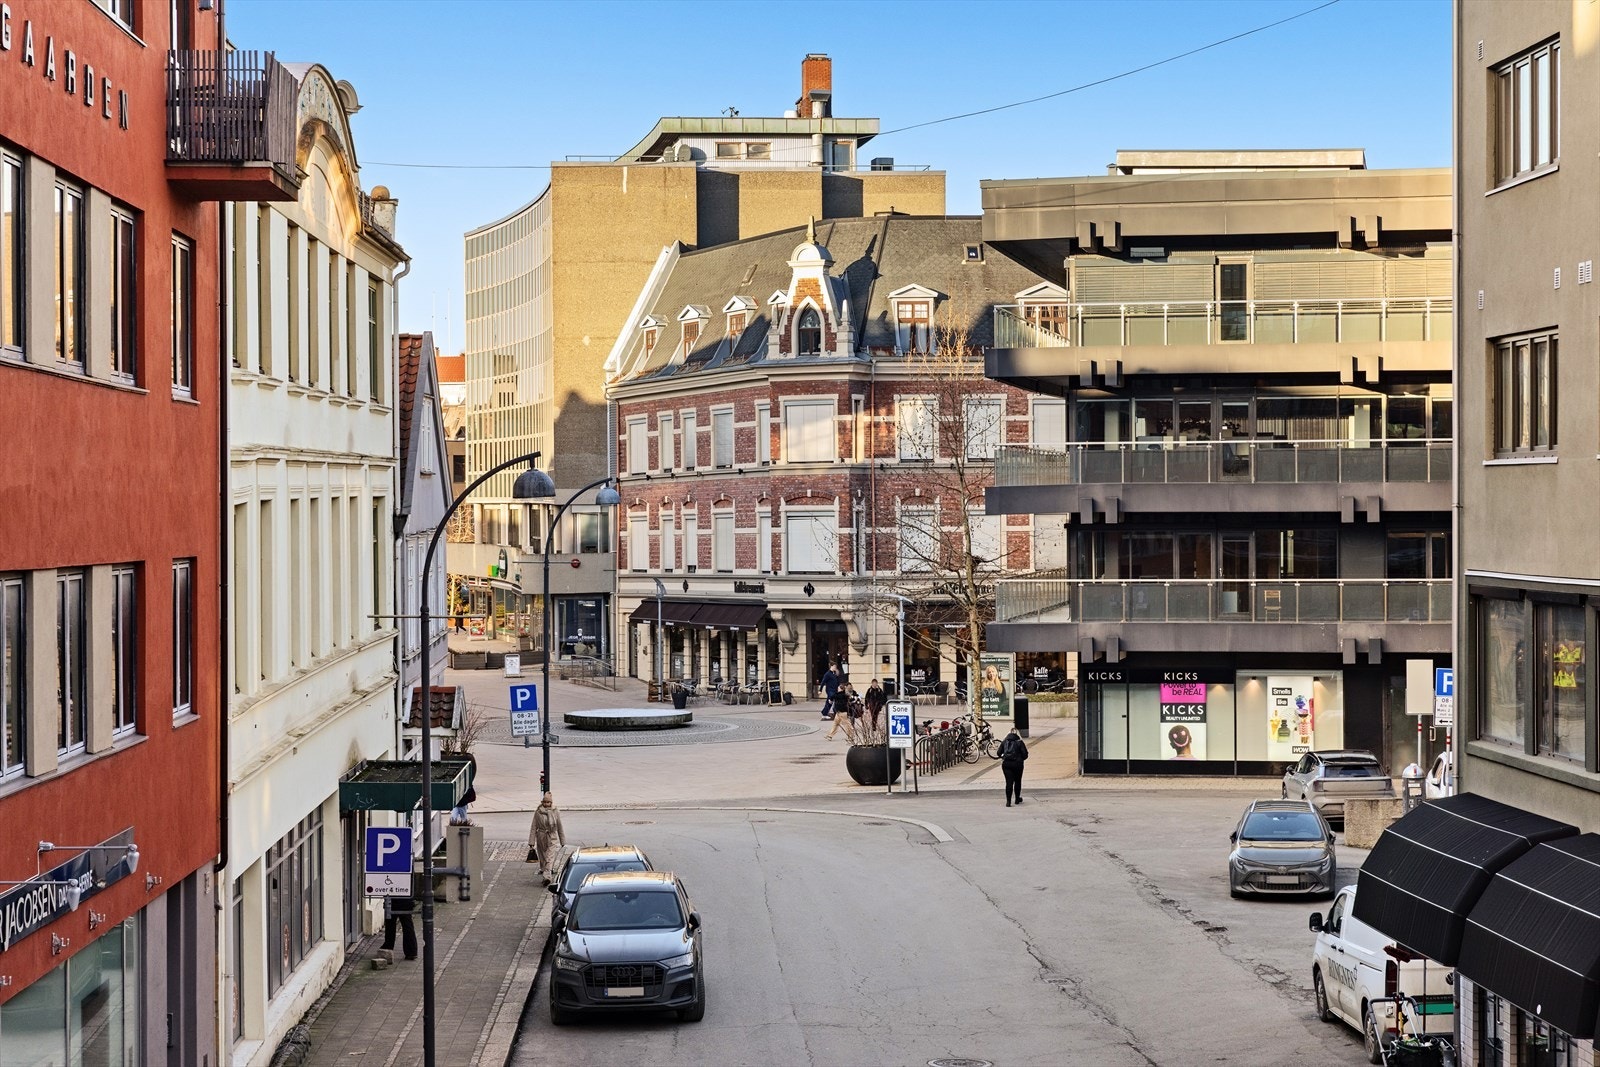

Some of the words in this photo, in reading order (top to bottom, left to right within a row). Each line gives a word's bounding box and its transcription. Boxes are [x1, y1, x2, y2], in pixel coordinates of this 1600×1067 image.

[1, 3, 129, 131] GAARDEN
[1088, 672, 1122, 680] KICKS
[1164, 672, 1198, 680] KICKS
[516, 688, 530, 708] P
[1163, 705, 1204, 714] KICKS
[377, 833, 400, 866] P
[4, 880, 56, 952] JACOBSEN
